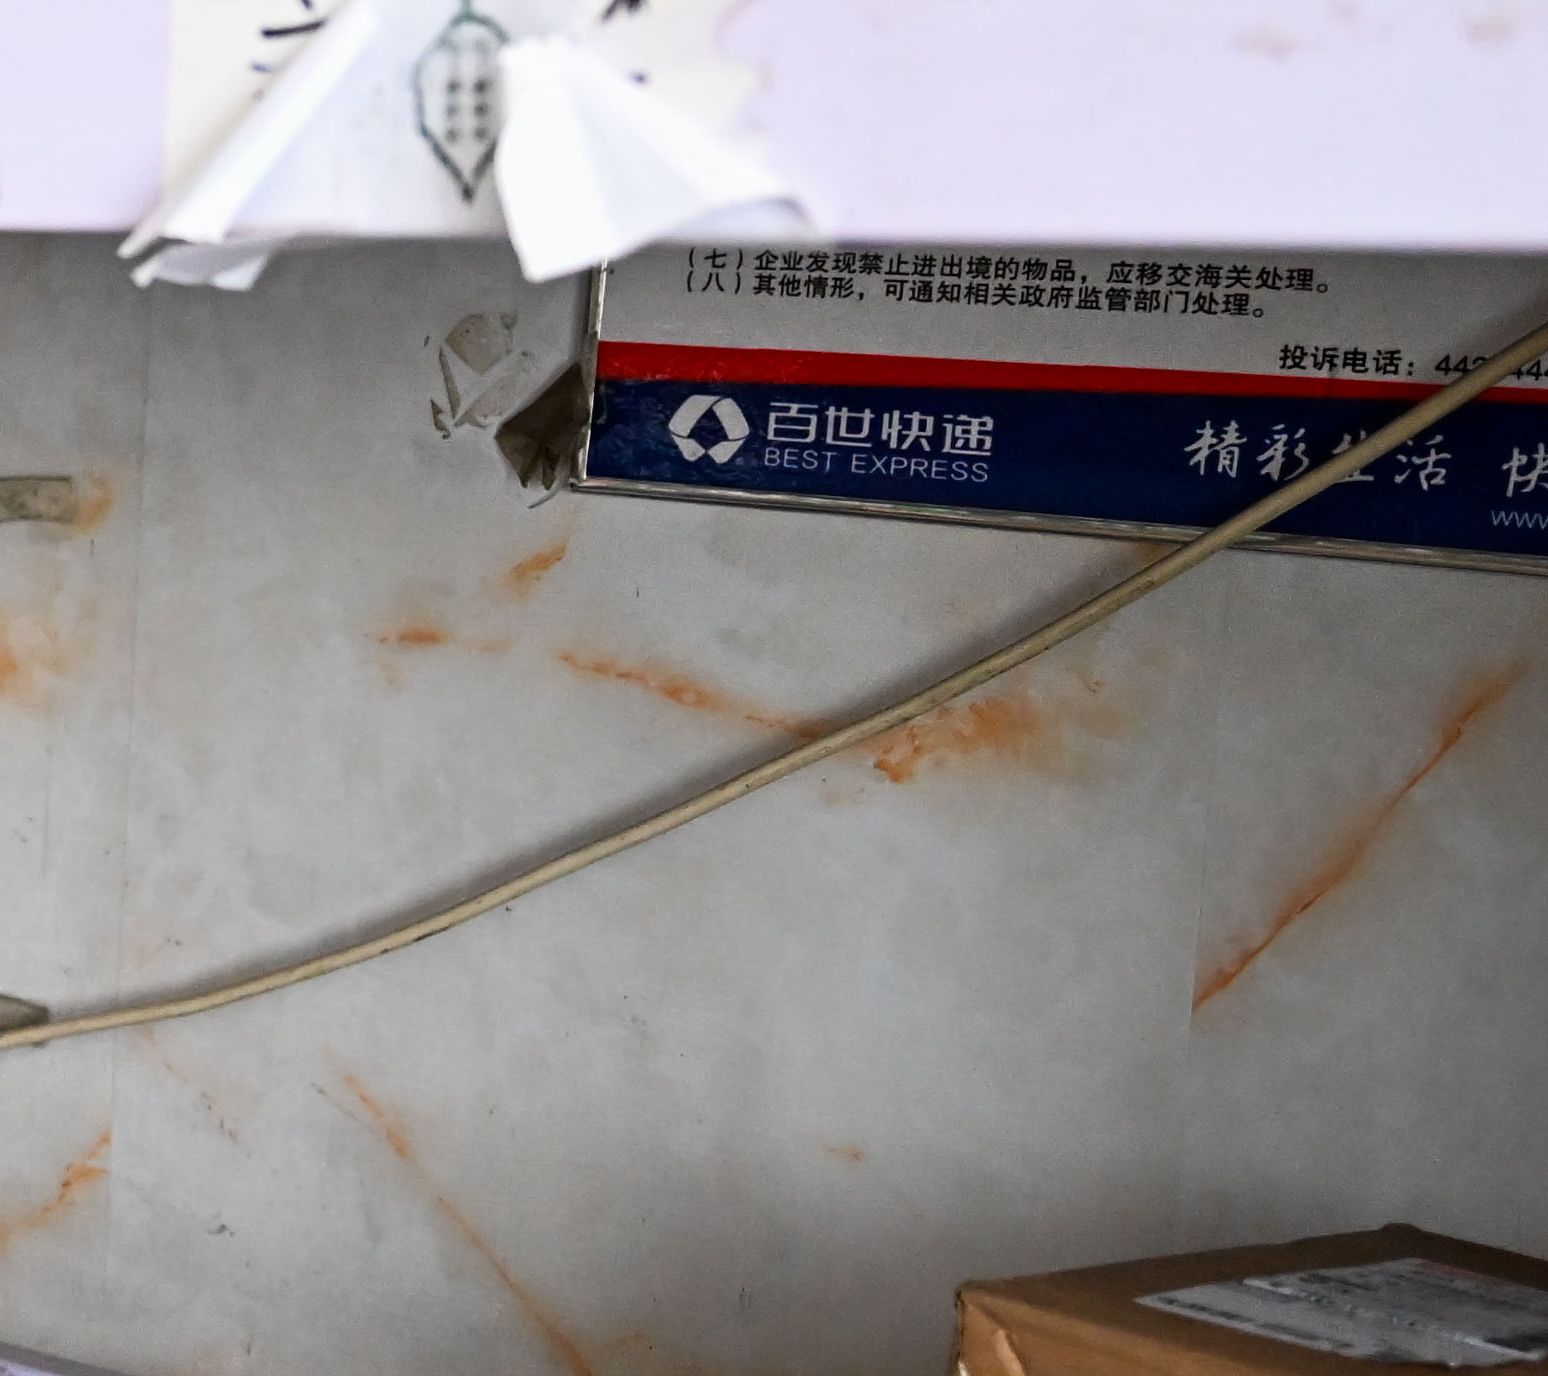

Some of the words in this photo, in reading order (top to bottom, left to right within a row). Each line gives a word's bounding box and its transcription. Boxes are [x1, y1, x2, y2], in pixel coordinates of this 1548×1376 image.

[766, 402, 994, 456] 百世快递
[764, 448, 841, 472] BEST
[851, 454, 989, 483] EXPRESS
